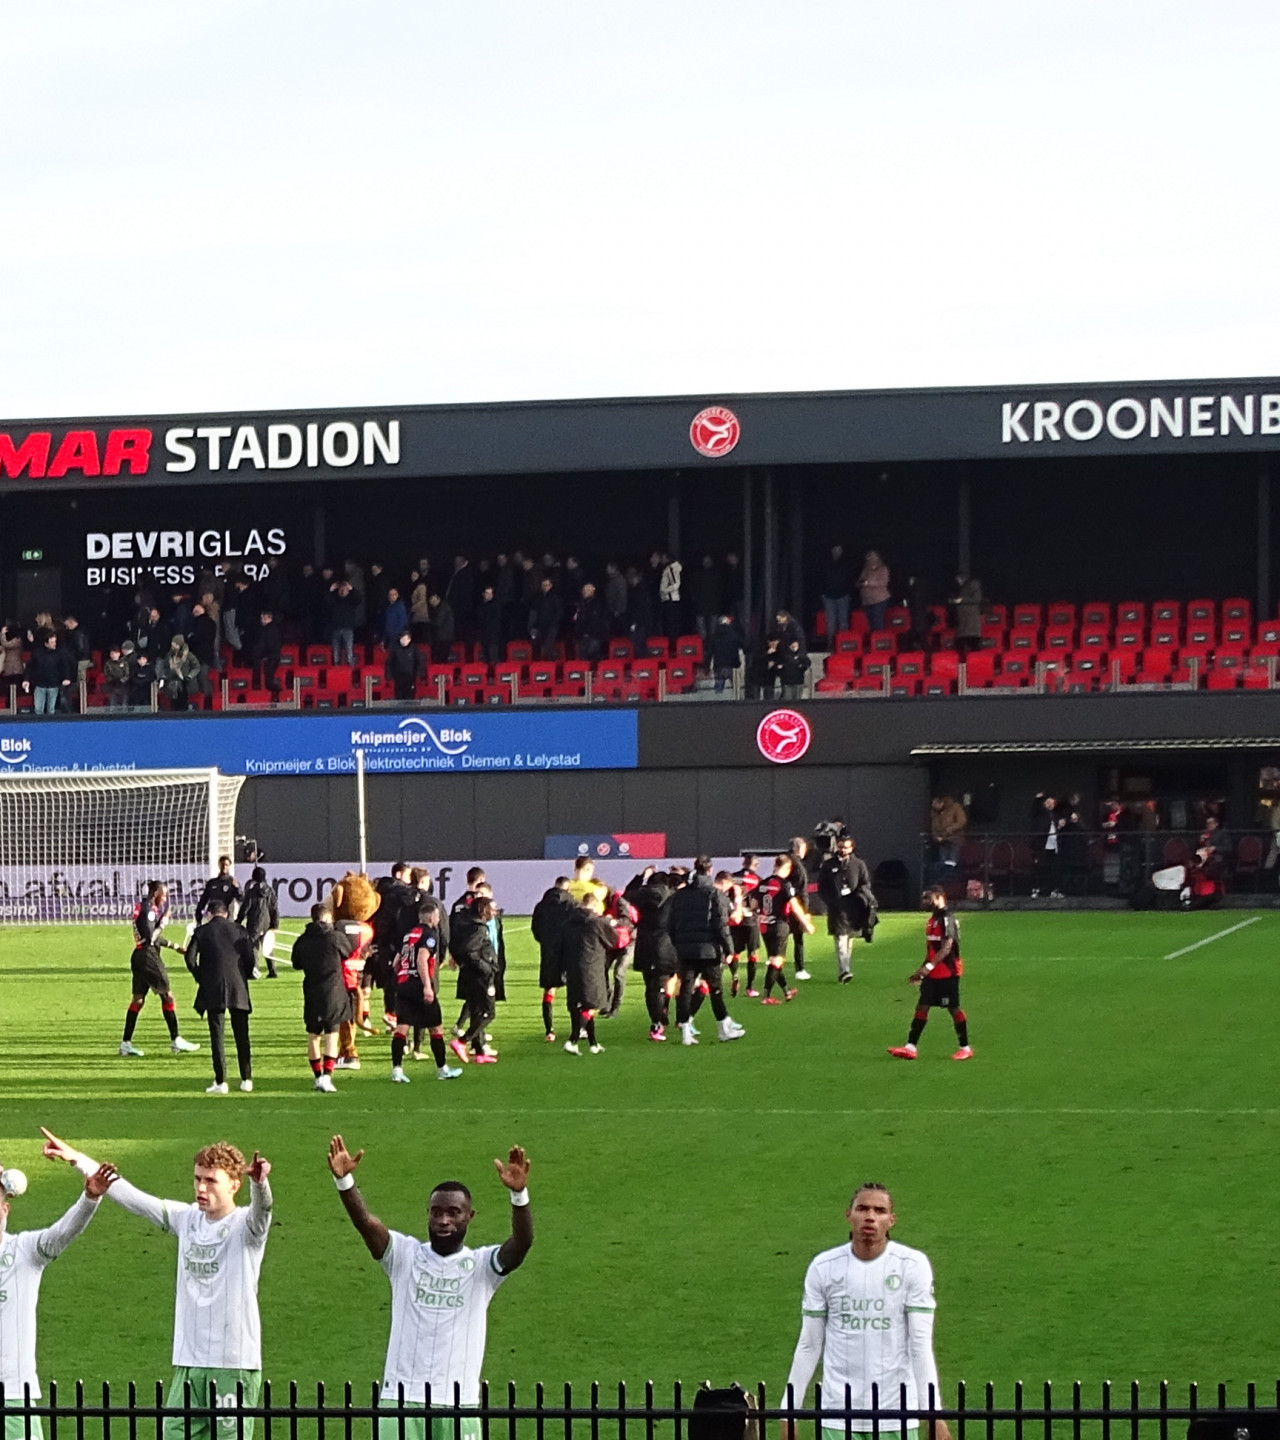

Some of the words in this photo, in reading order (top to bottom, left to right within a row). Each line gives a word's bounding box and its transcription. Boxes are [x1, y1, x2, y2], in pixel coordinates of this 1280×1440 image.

[1002, 394, 1280, 442] KROONENB
[165, 420, 400, 474] STADION
[87, 529, 286, 559] DEVRIGLAS
[1, 739, 31, 751] Blok
[351, 731, 426, 745] Knipmeijer
[440, 730, 471, 742] Blok
[246, 758, 311, 772] Knipmeijer
[315, 758, 324, 770] &
[328, 757, 356, 770] Blok
[462, 755, 510, 768] Diemen
[514, 755, 523, 767] &
[526, 754, 580, 769] Lelystad
[414, 1287, 464, 1307] Parcs
[841, 1296, 884, 1311] Euro
[840, 1314, 891, 1330] Parcs
